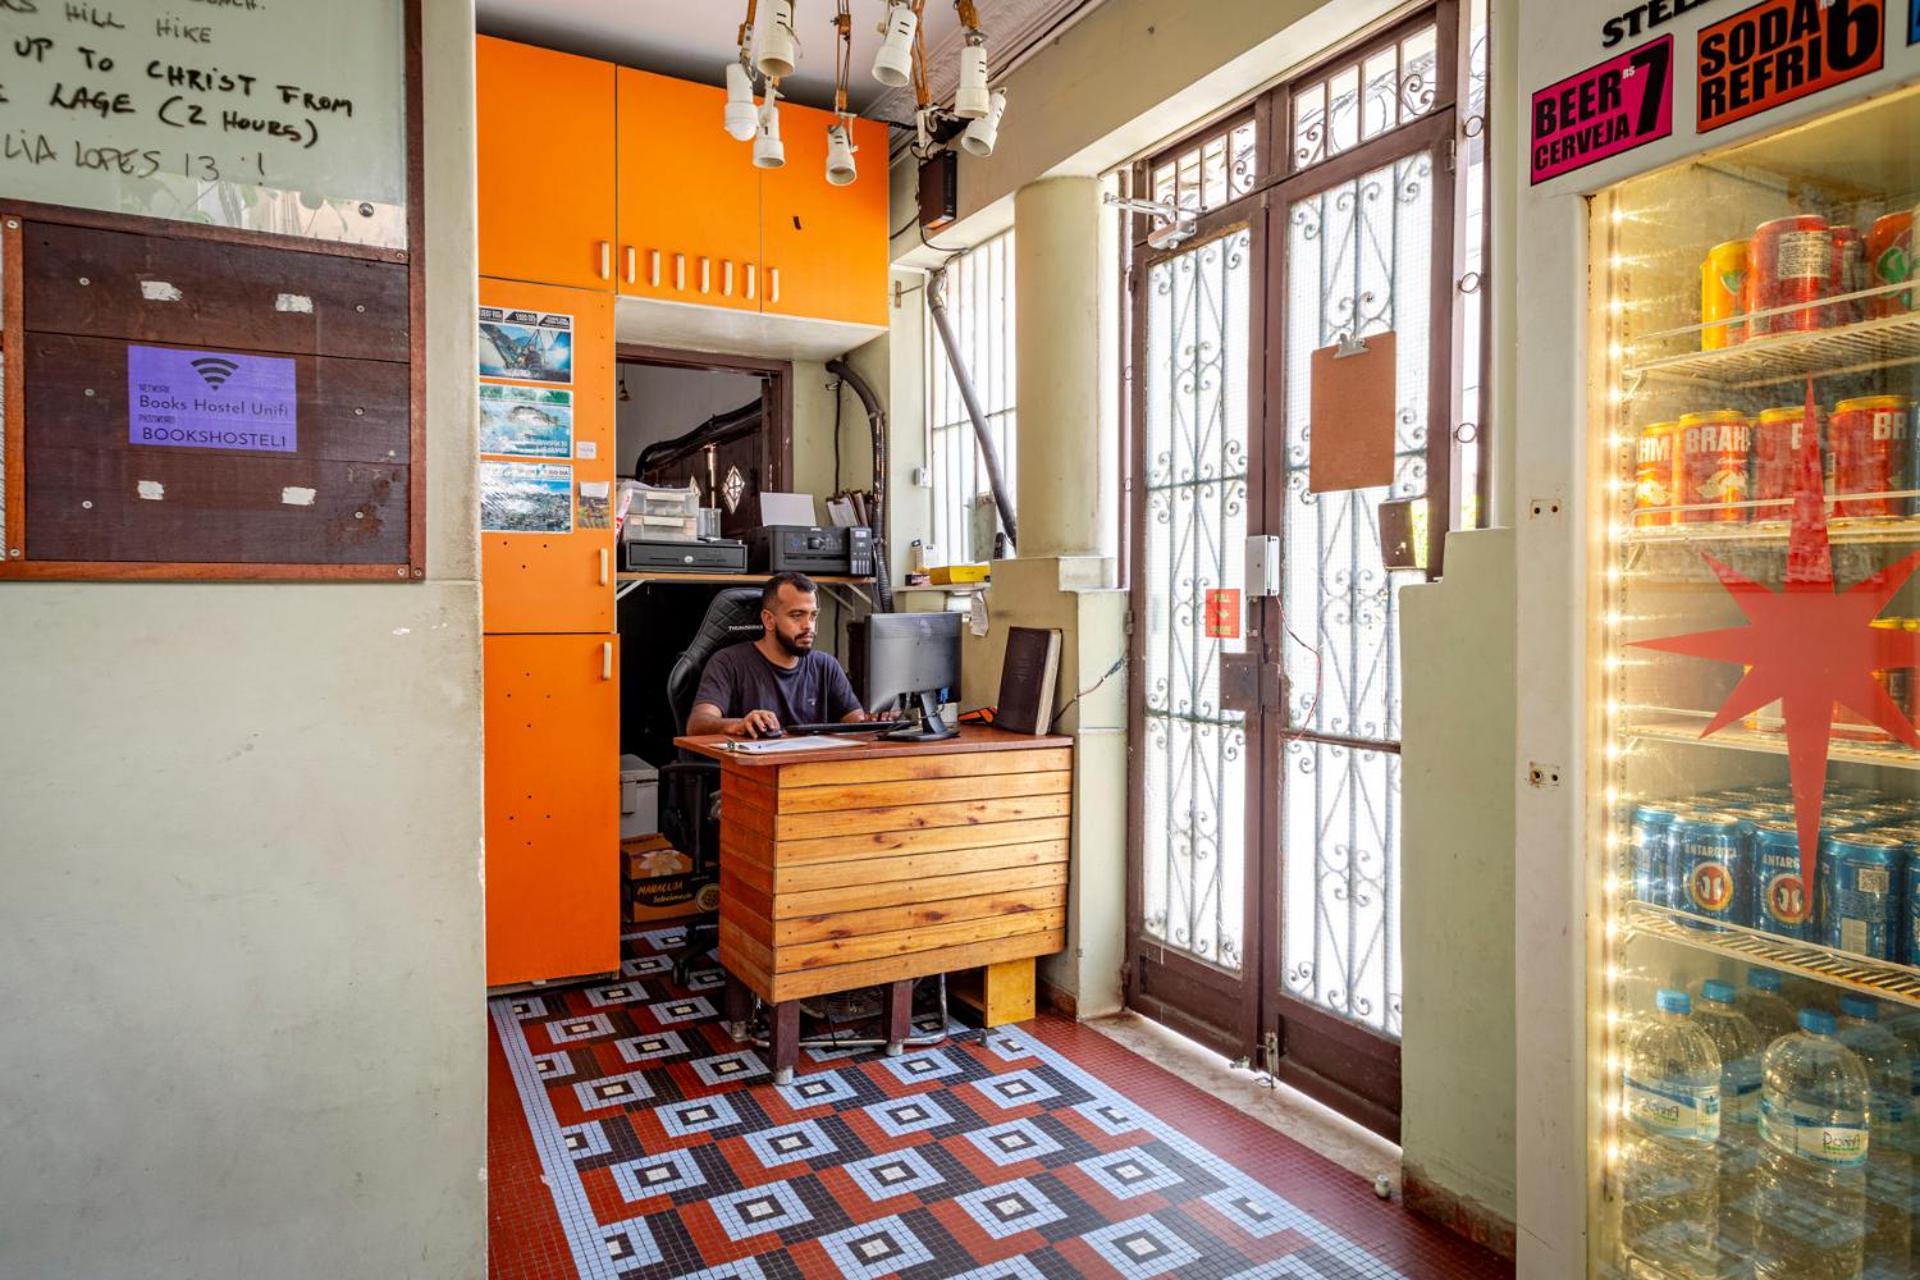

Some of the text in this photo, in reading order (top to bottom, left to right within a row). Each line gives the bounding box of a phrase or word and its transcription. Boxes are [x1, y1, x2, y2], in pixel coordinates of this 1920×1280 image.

[1602, 0, 1712, 48] STEL
[1700, 0, 1822, 77] SODA
[1826, 0, 1880, 72] 6
[14, 36, 54, 63] UP
[77, 46, 114, 72] TO
[275, 85, 352, 118] FROM
[1534, 69, 1622, 141] BEER
[1629, 43, 1669, 137] 7
[1700, 38, 1822, 122] REFRI
[49, 82, 136, 119] LAGE
[158, 95, 208, 128] (2
[222, 111, 318, 149] HOURS)
[1534, 113, 1631, 172] CERVEJA
[75, 141, 161, 180] LOPES
[139, 394, 289, 416] Books Hostel Unifi
